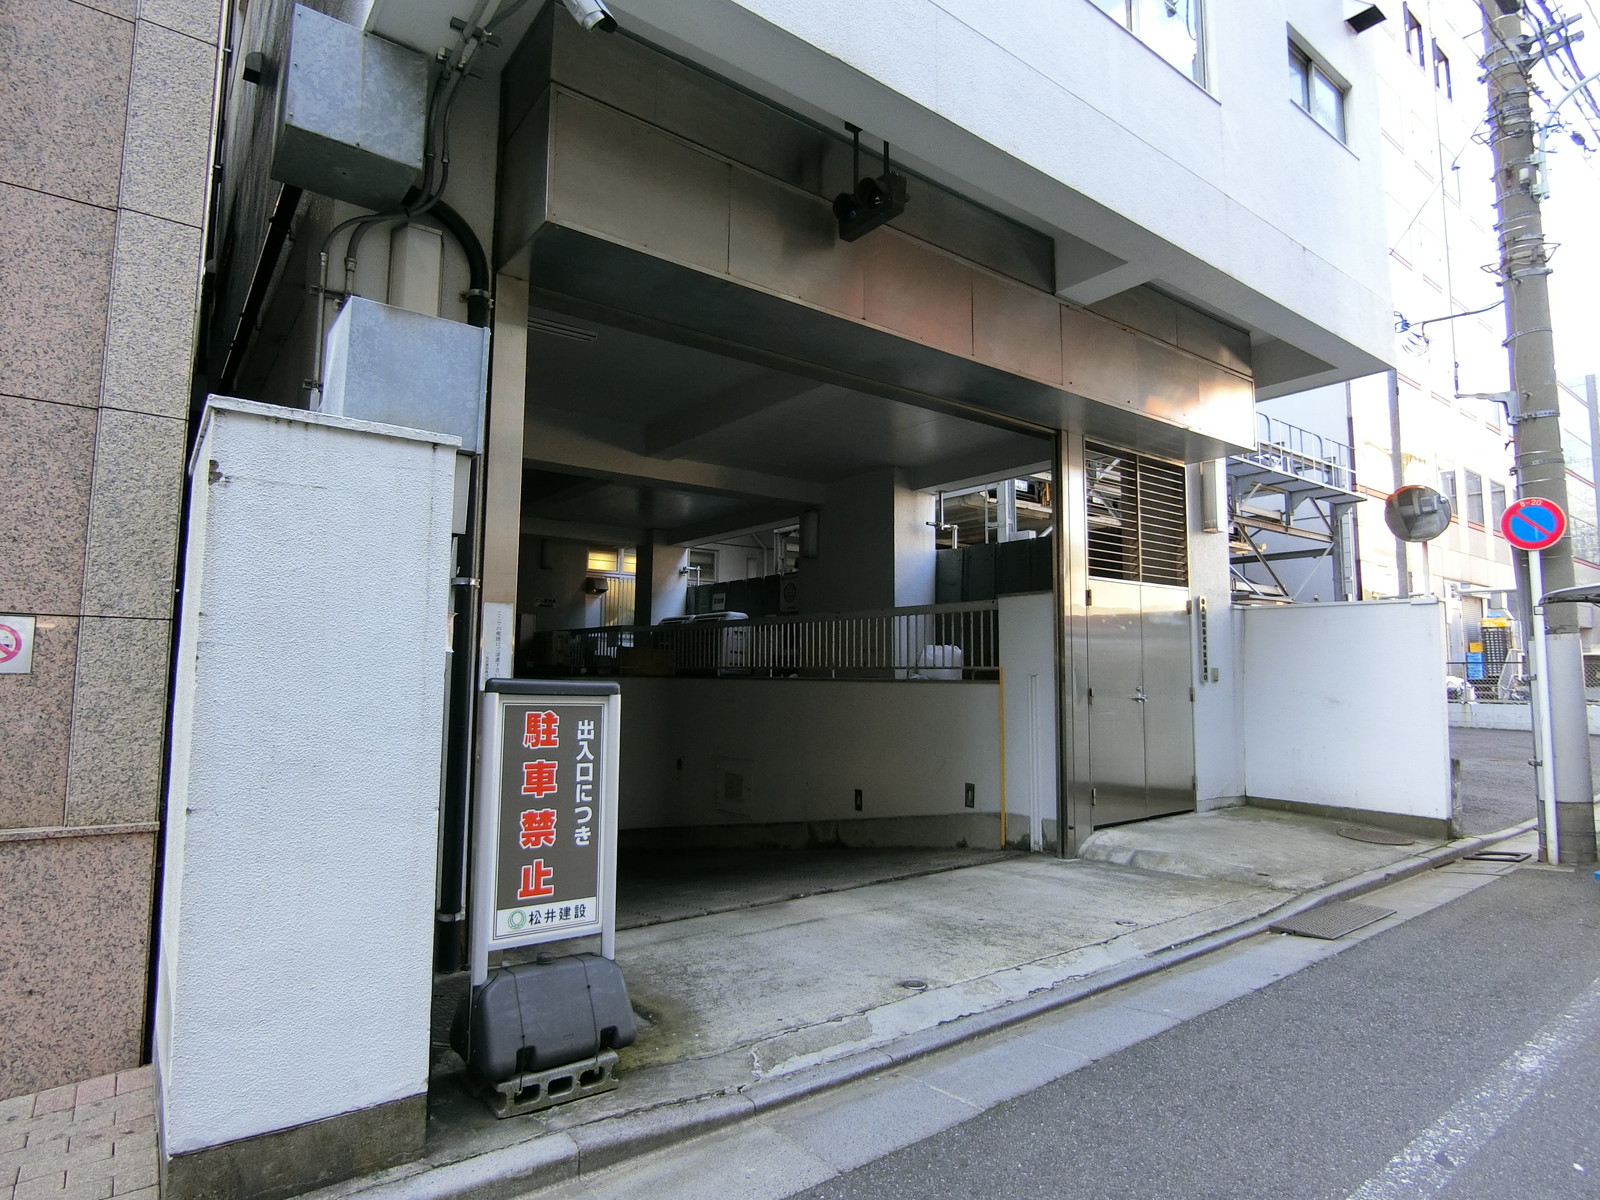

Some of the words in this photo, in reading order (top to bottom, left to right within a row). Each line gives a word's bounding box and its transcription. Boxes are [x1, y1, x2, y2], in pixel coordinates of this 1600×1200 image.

[517, 710, 560, 901] 駐車禁止
[574, 719, 595, 846] 出入口につき
[528, 904, 587, 926] 松井建設
